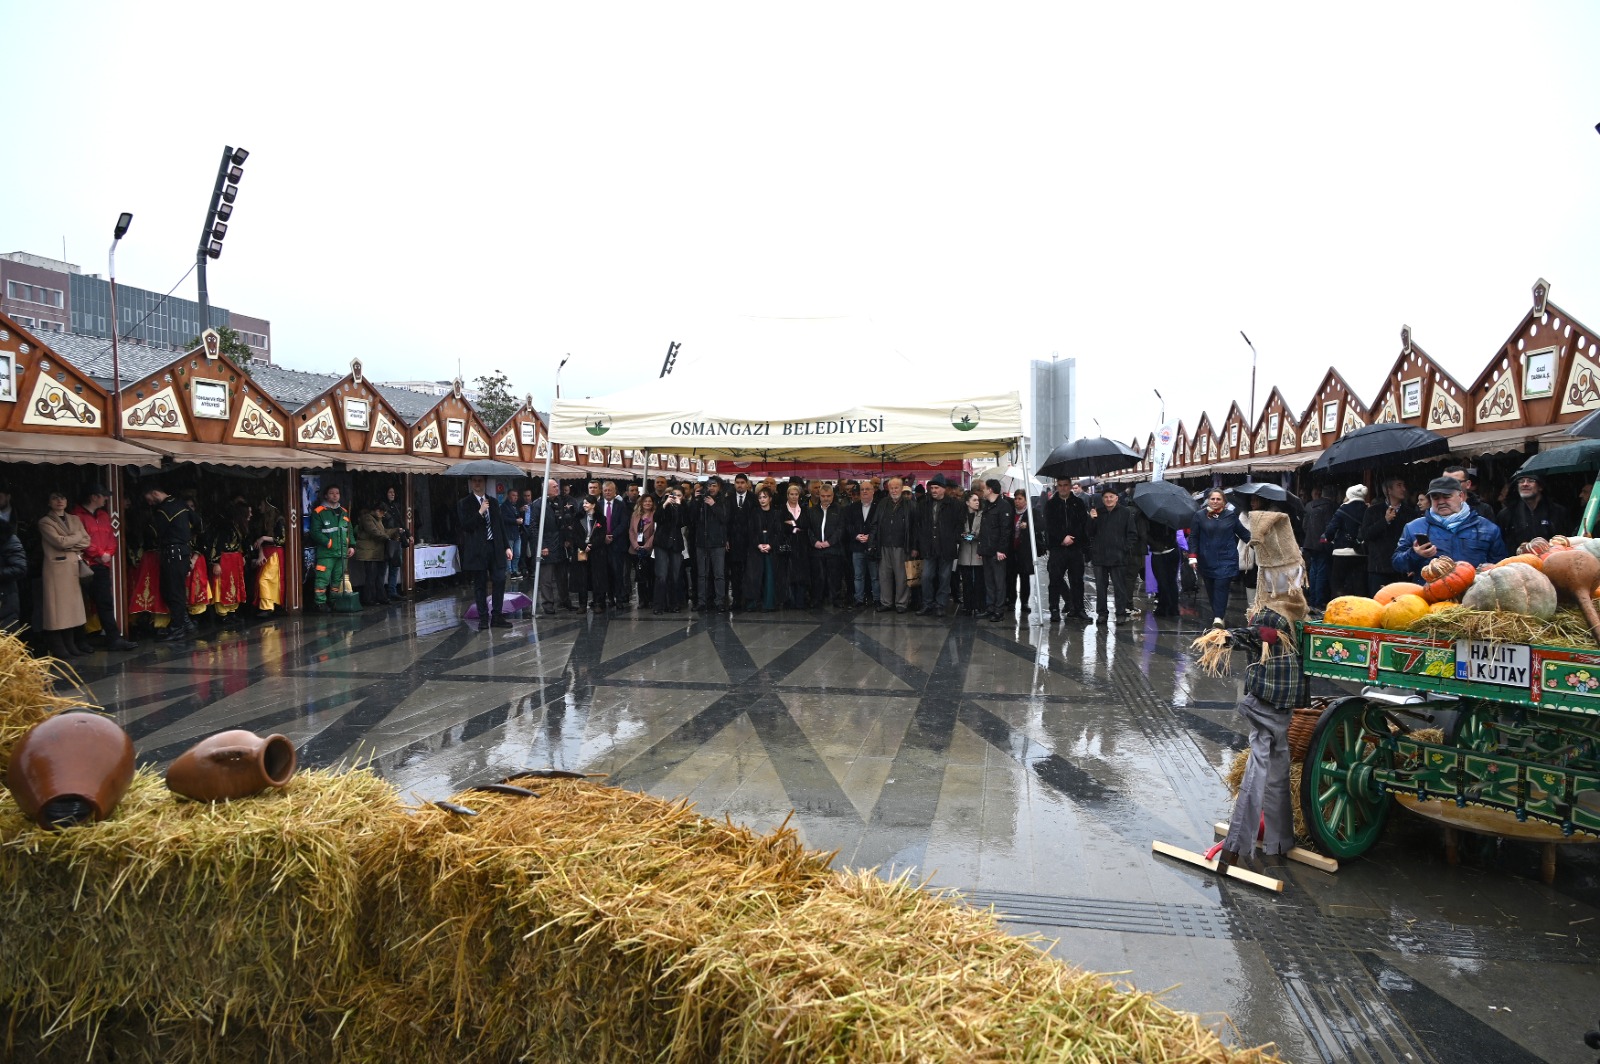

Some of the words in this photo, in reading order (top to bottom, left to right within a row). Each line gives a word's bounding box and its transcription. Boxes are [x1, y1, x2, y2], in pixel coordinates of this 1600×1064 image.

[670, 420, 770, 436] OSMANGAZİ
[783, 414, 884, 436] BELEDİYESİ
[1477, 662, 1527, 683] KUTAY
